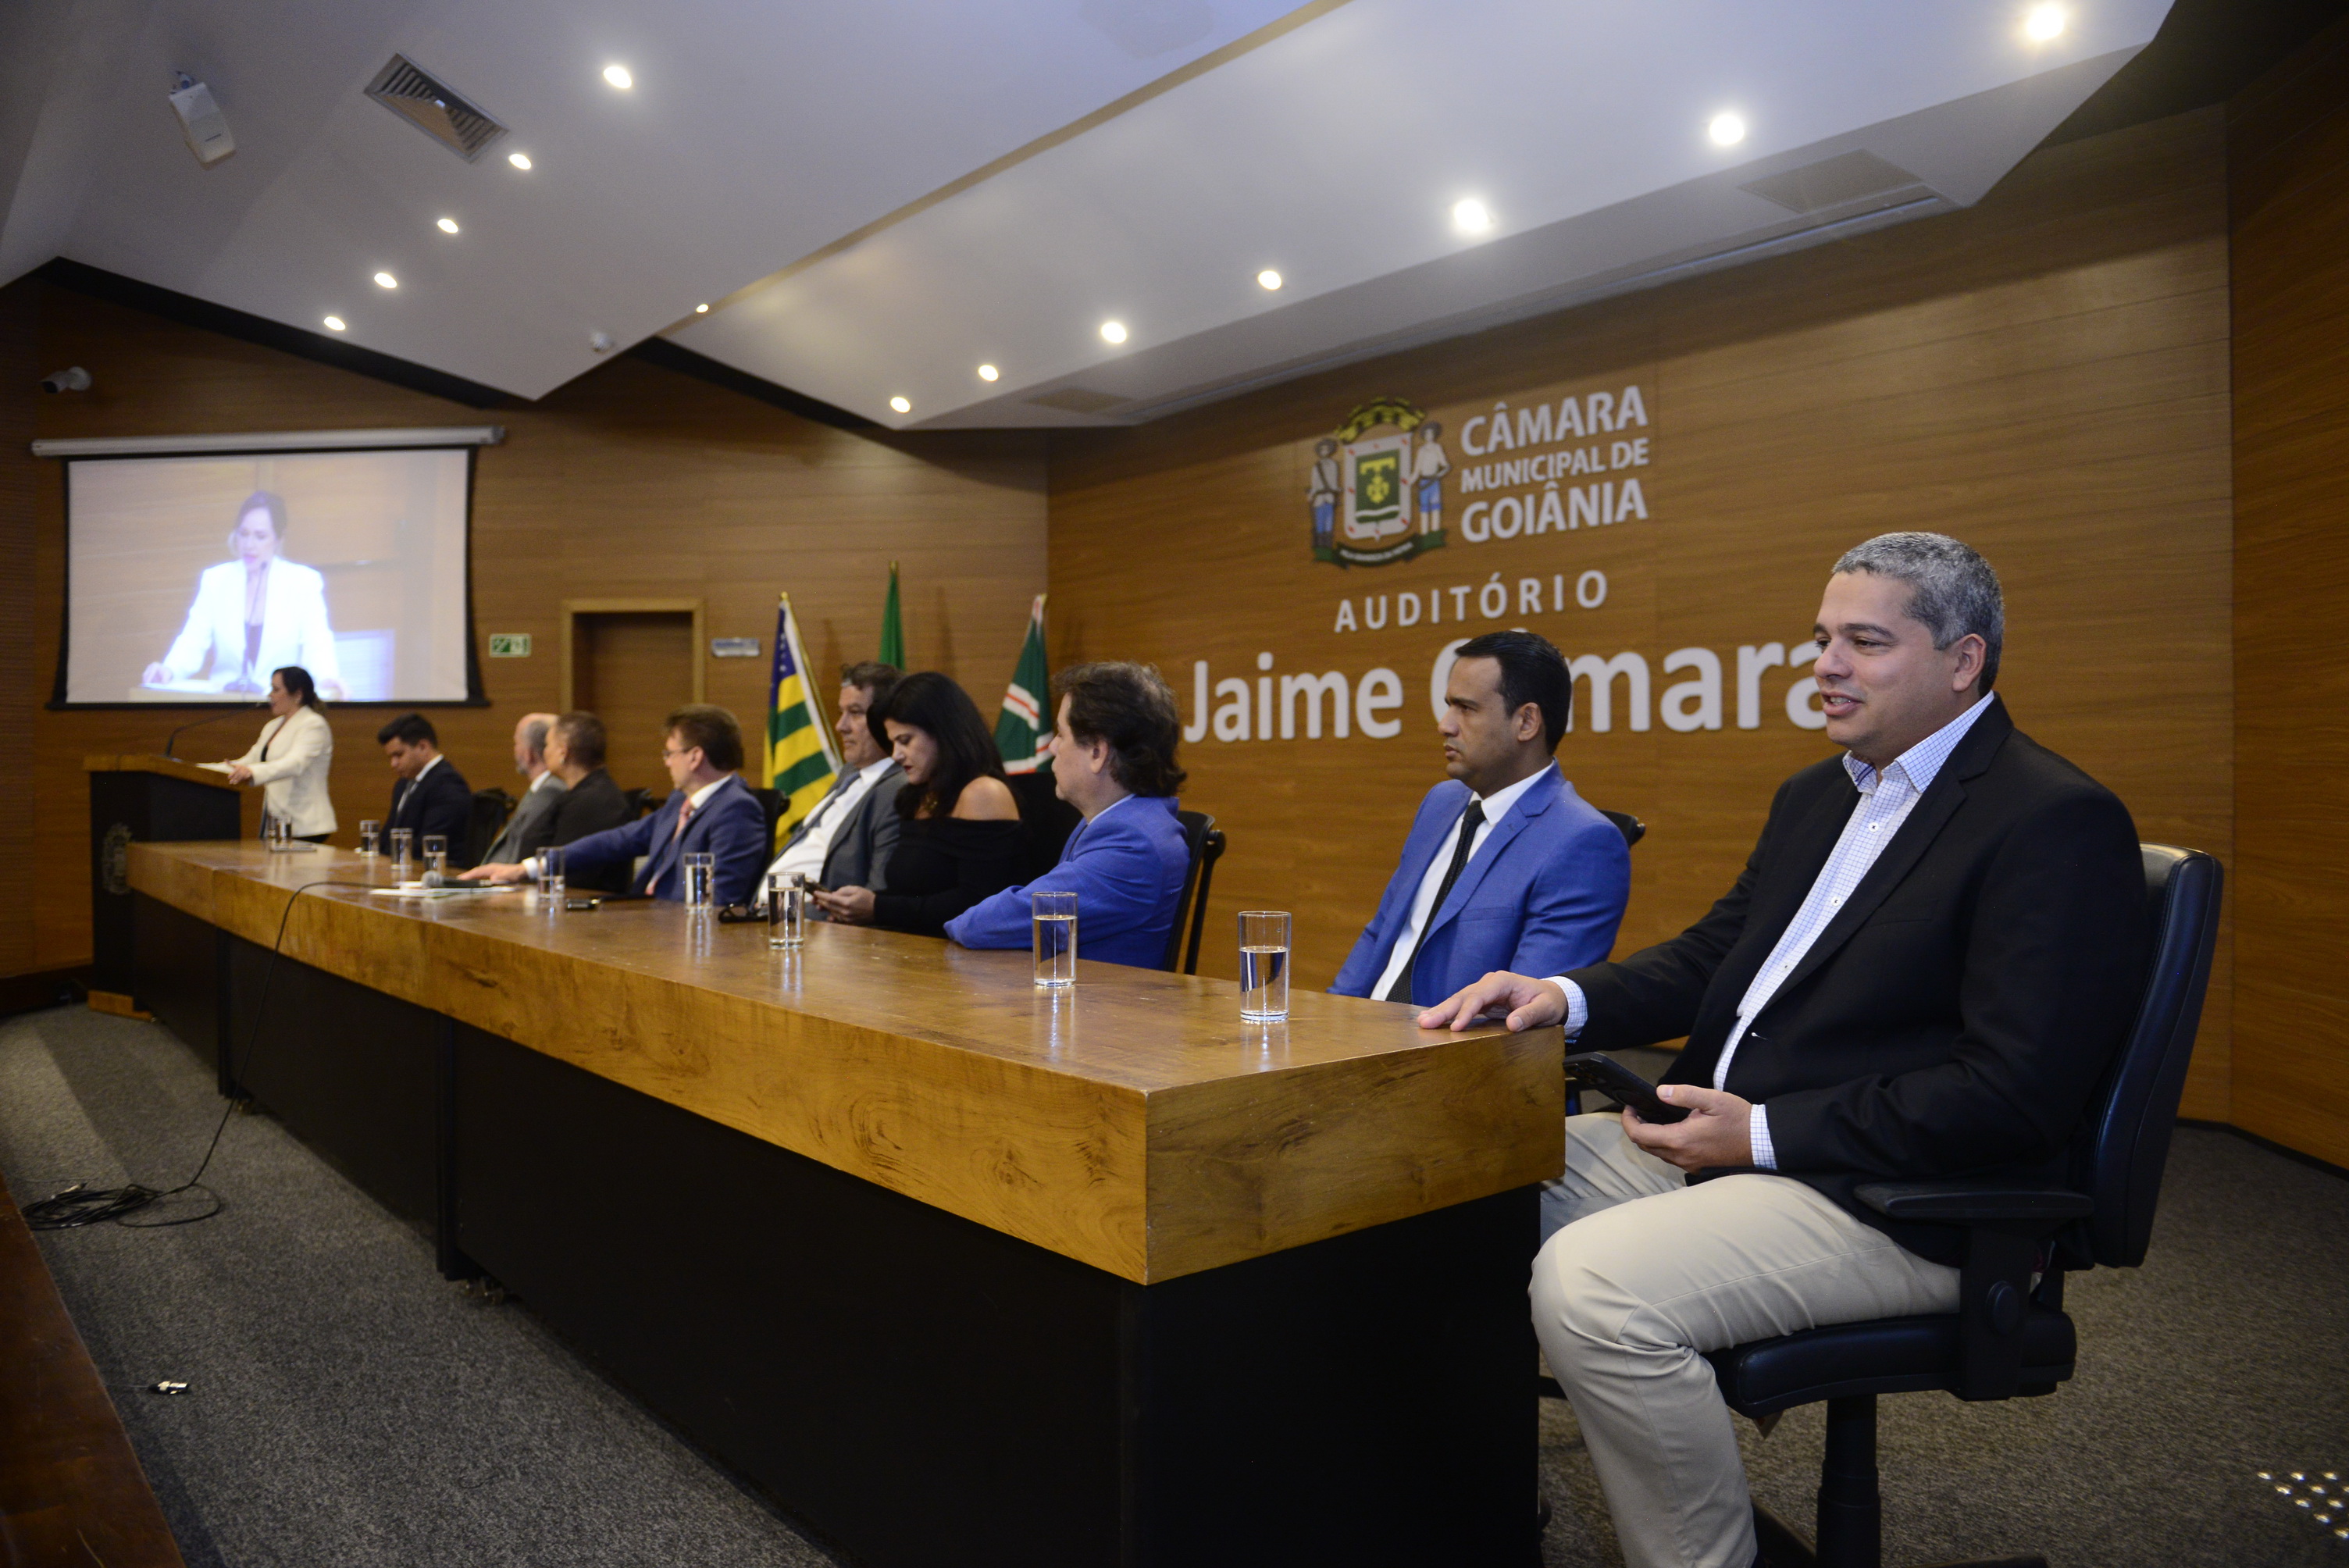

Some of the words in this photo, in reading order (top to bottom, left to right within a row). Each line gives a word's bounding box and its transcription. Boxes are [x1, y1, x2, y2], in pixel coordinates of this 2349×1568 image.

[1461, 385, 1649, 456] CÂMARA
[1460, 446, 1606, 494] MUNICIPAL
[1610, 437, 1650, 470] DE
[1461, 478, 1649, 543] GOIÂNIA
[1334, 569, 1608, 633] AUDITÓRIO
[1183, 650, 1404, 743] Jaime
